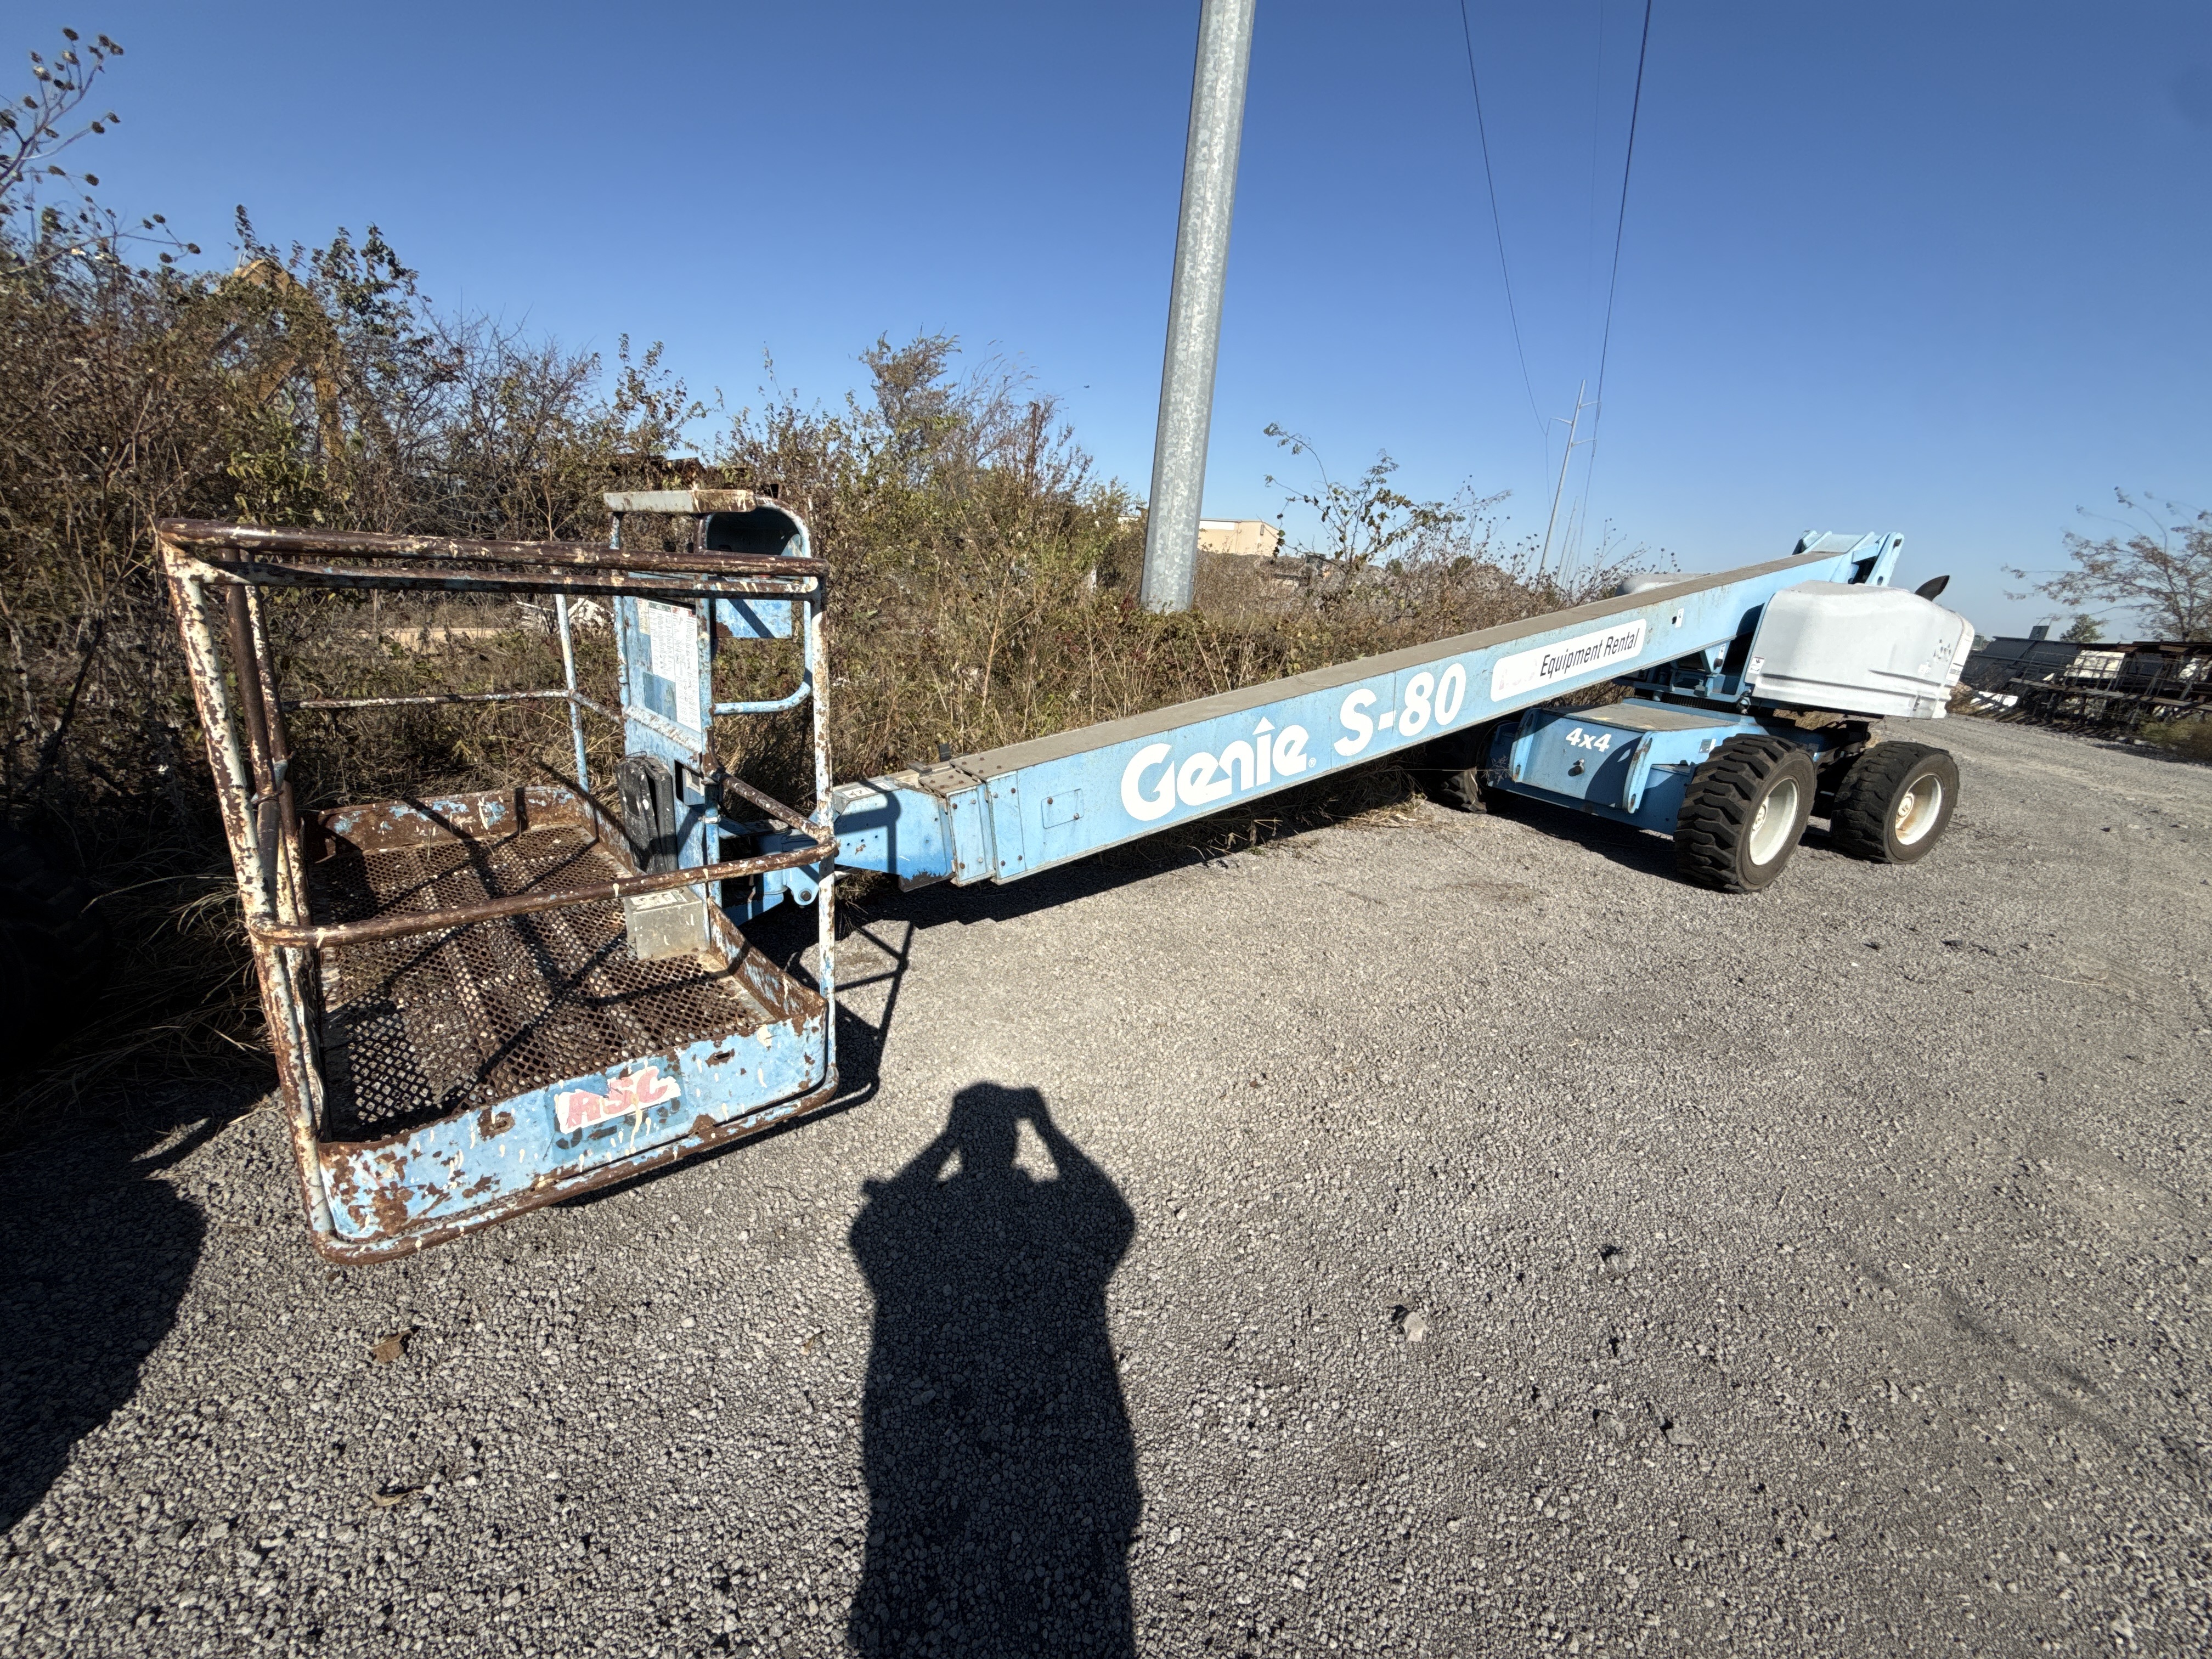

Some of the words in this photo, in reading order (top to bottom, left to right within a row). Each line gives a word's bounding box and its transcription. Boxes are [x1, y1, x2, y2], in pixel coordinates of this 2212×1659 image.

[1539, 639, 1604, 679] Equipment
[1603, 628, 1640, 657] Rental
[1333, 663, 1466, 757] S-80
[1565, 727, 1612, 752] 4x4
